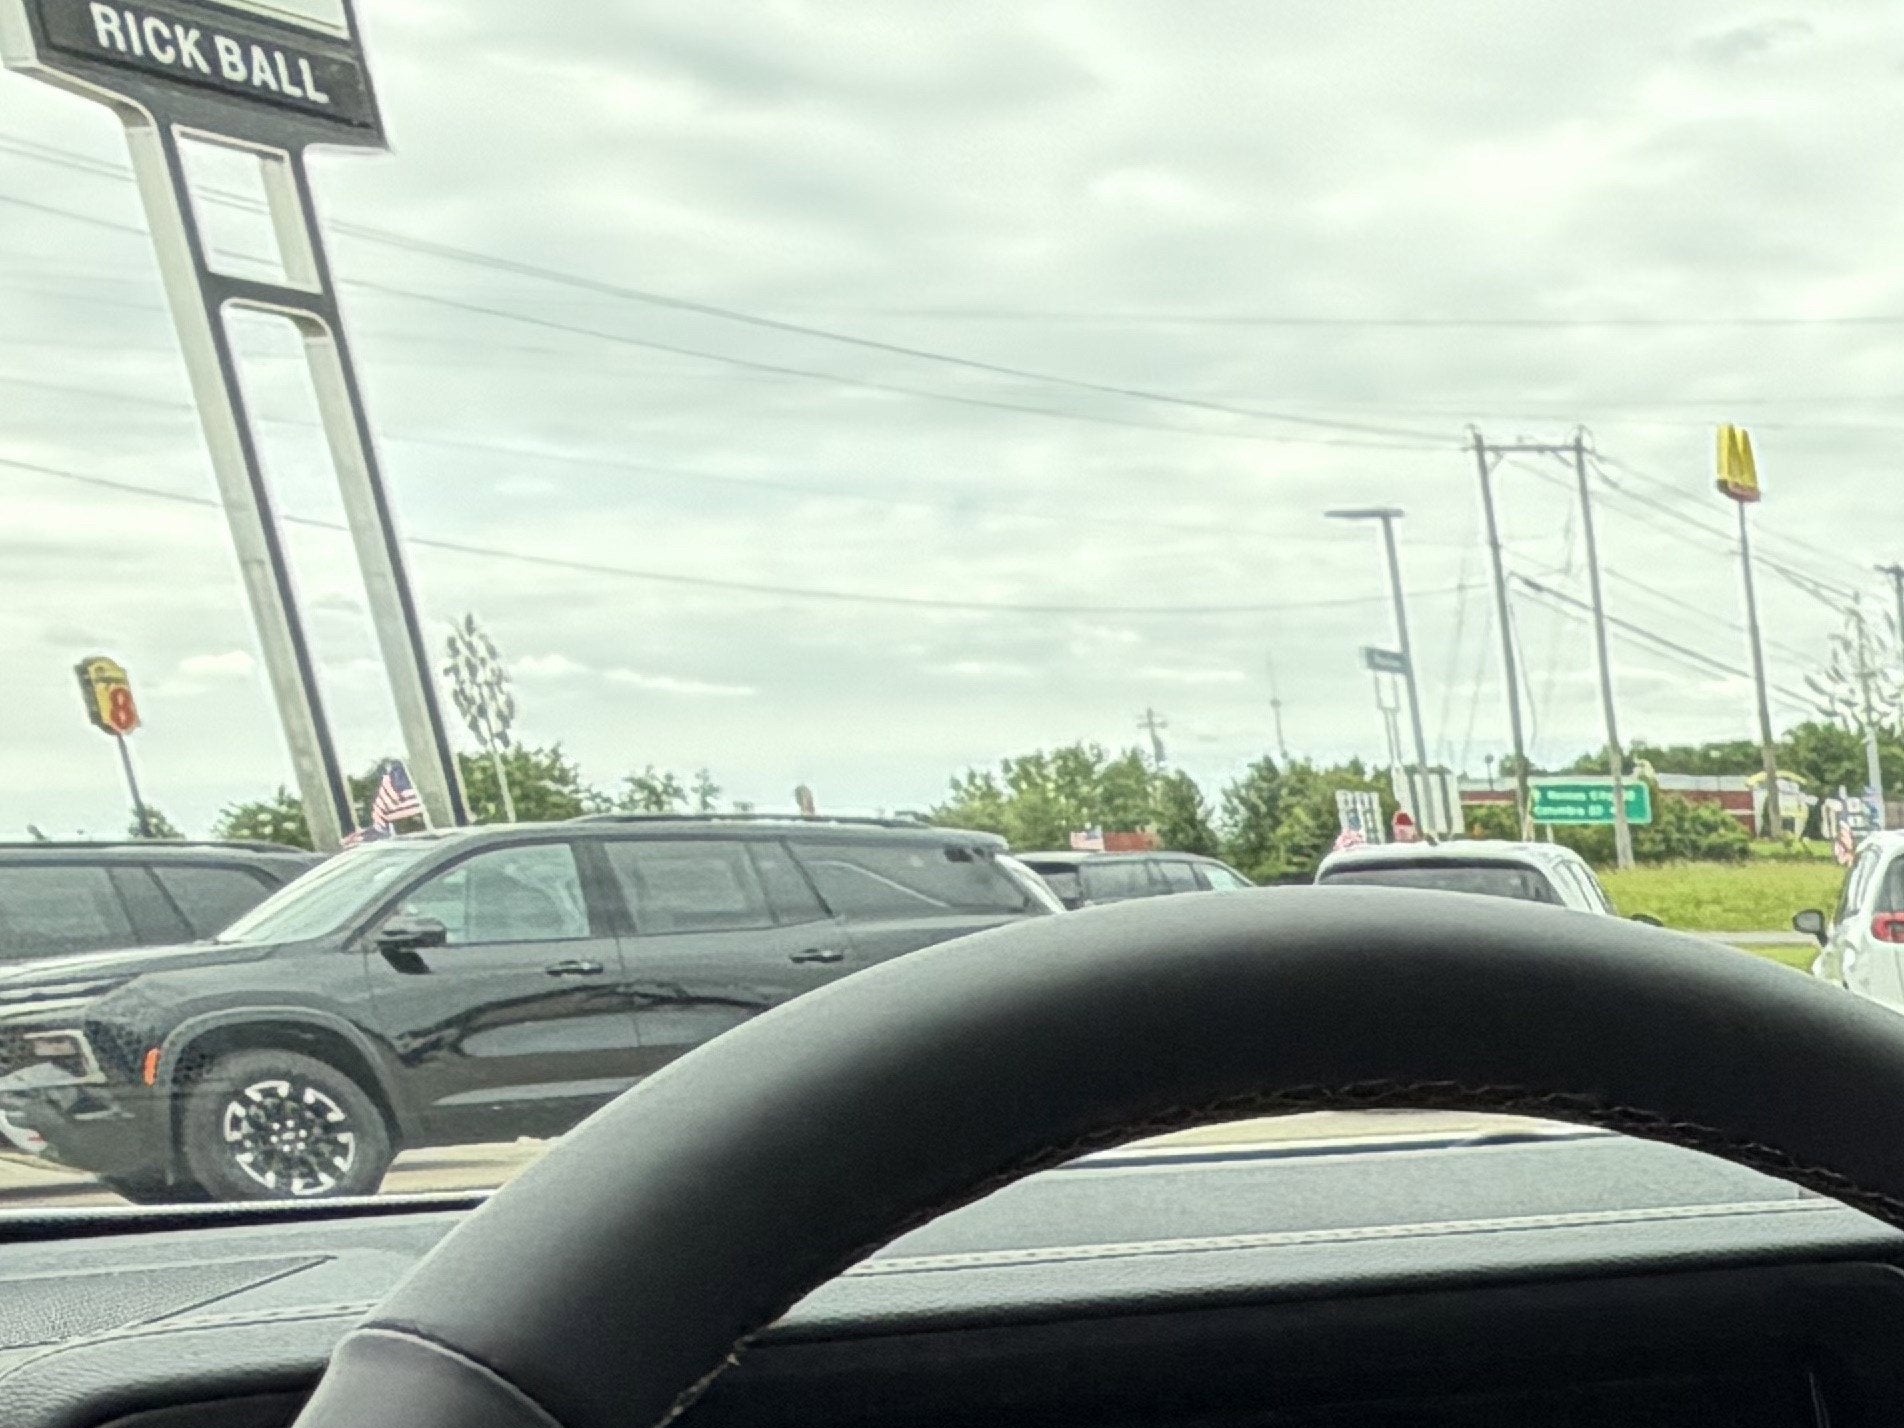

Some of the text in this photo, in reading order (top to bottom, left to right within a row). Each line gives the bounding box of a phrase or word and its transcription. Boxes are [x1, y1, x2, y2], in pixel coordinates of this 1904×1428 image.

[90, 1, 331, 104] RICK BALL
[109, 687, 137, 730] 8
